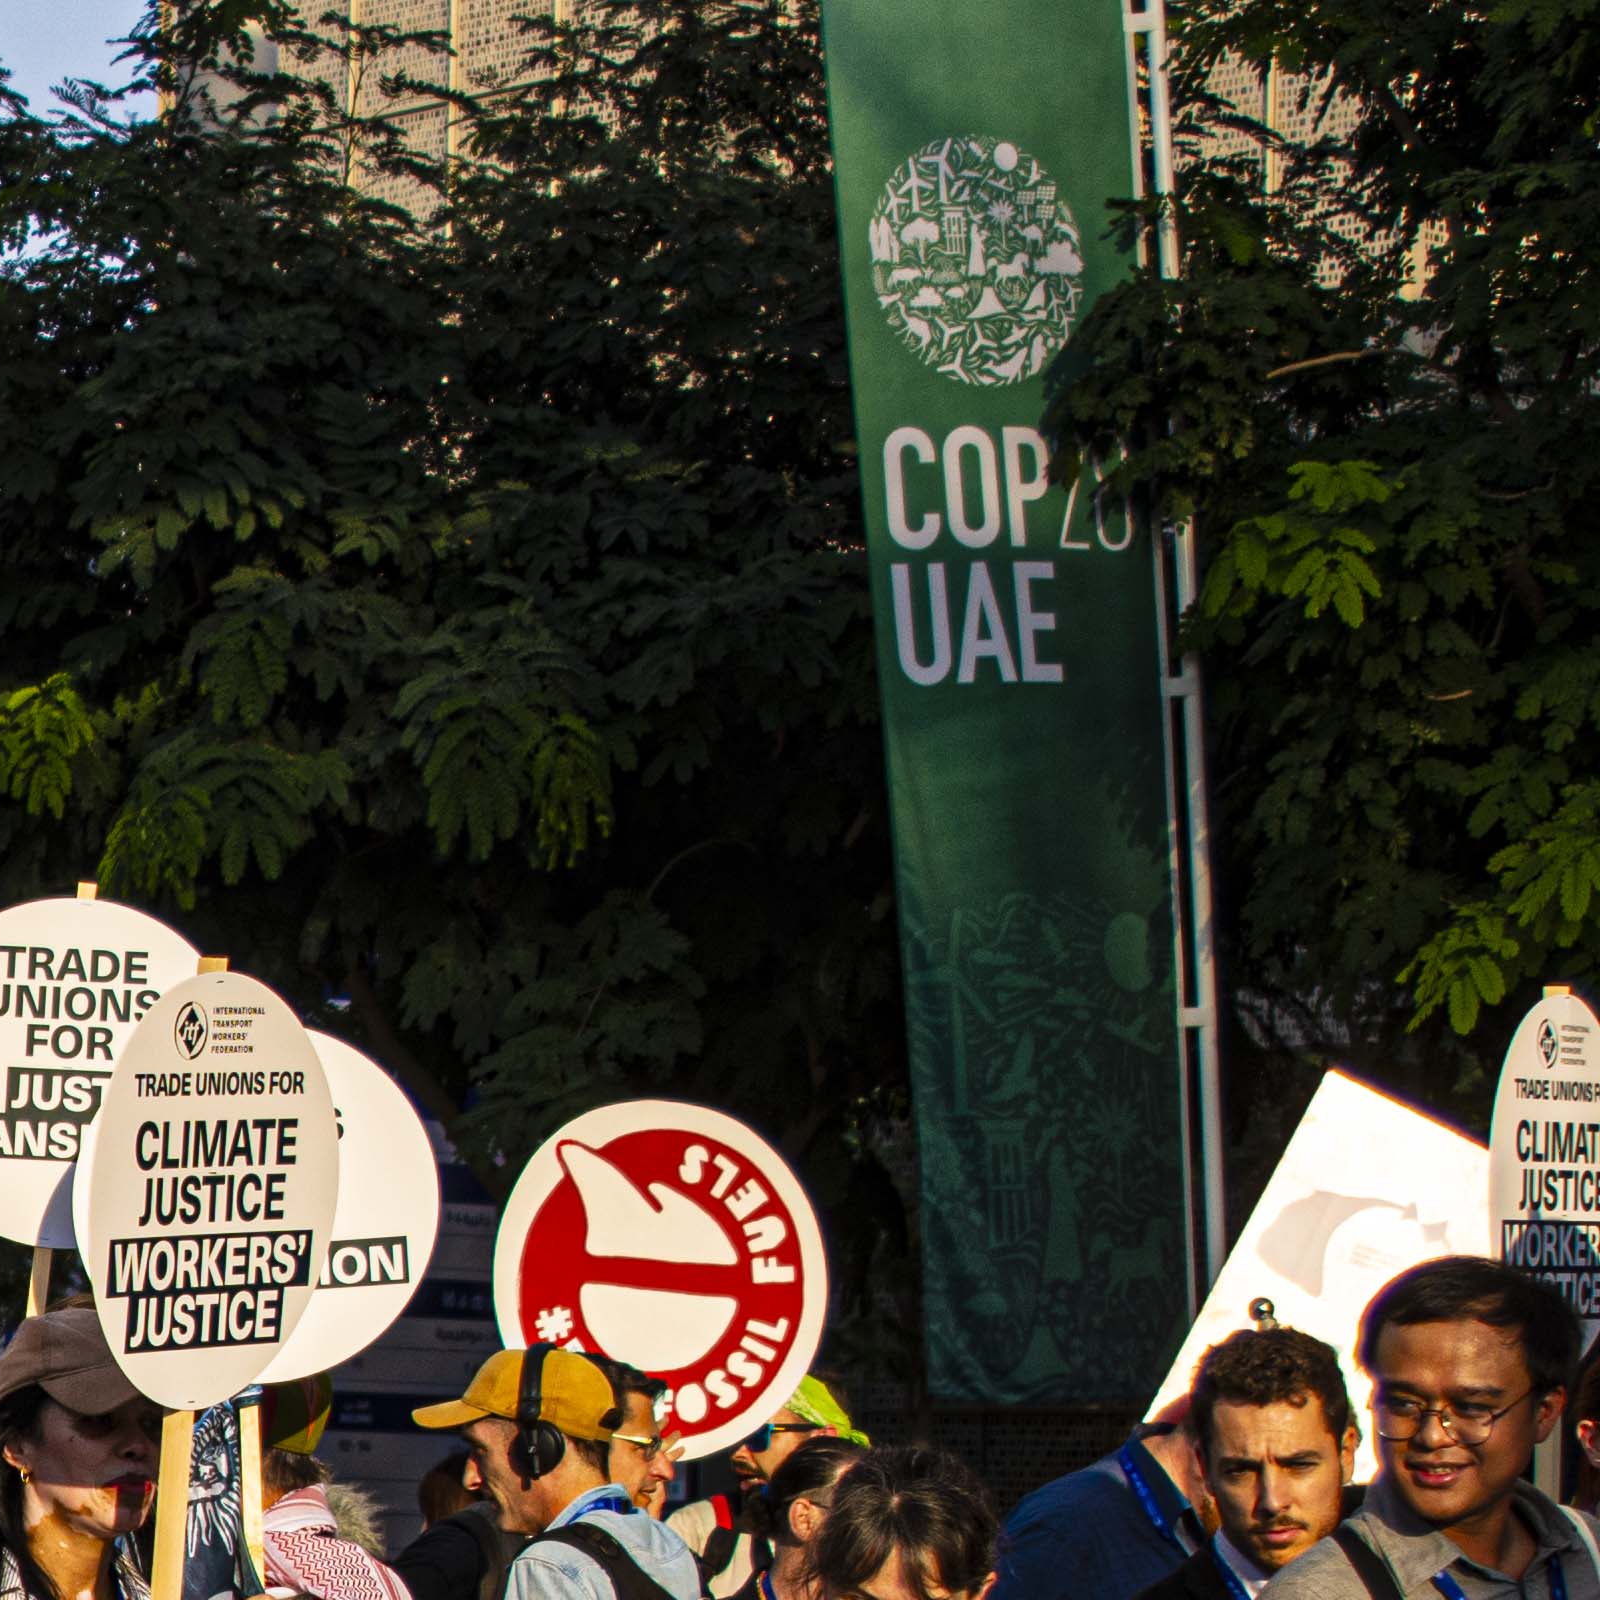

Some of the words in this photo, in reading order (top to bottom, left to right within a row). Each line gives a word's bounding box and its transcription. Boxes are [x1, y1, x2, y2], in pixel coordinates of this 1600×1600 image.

[890, 561, 1064, 686] UAE
[213, 1007, 266, 1015] INTERNATIONAL
[213, 1020, 253, 1028] TRANSPORT
[25, 1024, 114, 1061] FOR
[211, 1045, 254, 1054] FEDERATION
[135, 1072, 192, 1097] TRADE
[195, 1071, 265, 1096] UNIONS
[268, 1071, 305, 1095] FOR
[1514, 1078, 1549, 1100] TRADE
[1551, 1080, 1593, 1102] UNIONS
[134, 1118, 299, 1170] CLIMATE
[1516, 1119, 1600, 1164] CLIMAT
[138, 1173, 287, 1227] JUSTICE
[679, 1144, 795, 1285] FUELS
[113, 1234, 307, 1293] WORKERS'
[1504, 1223, 1600, 1267] WORKER
[129, 1290, 280, 1348] JUSTICE
